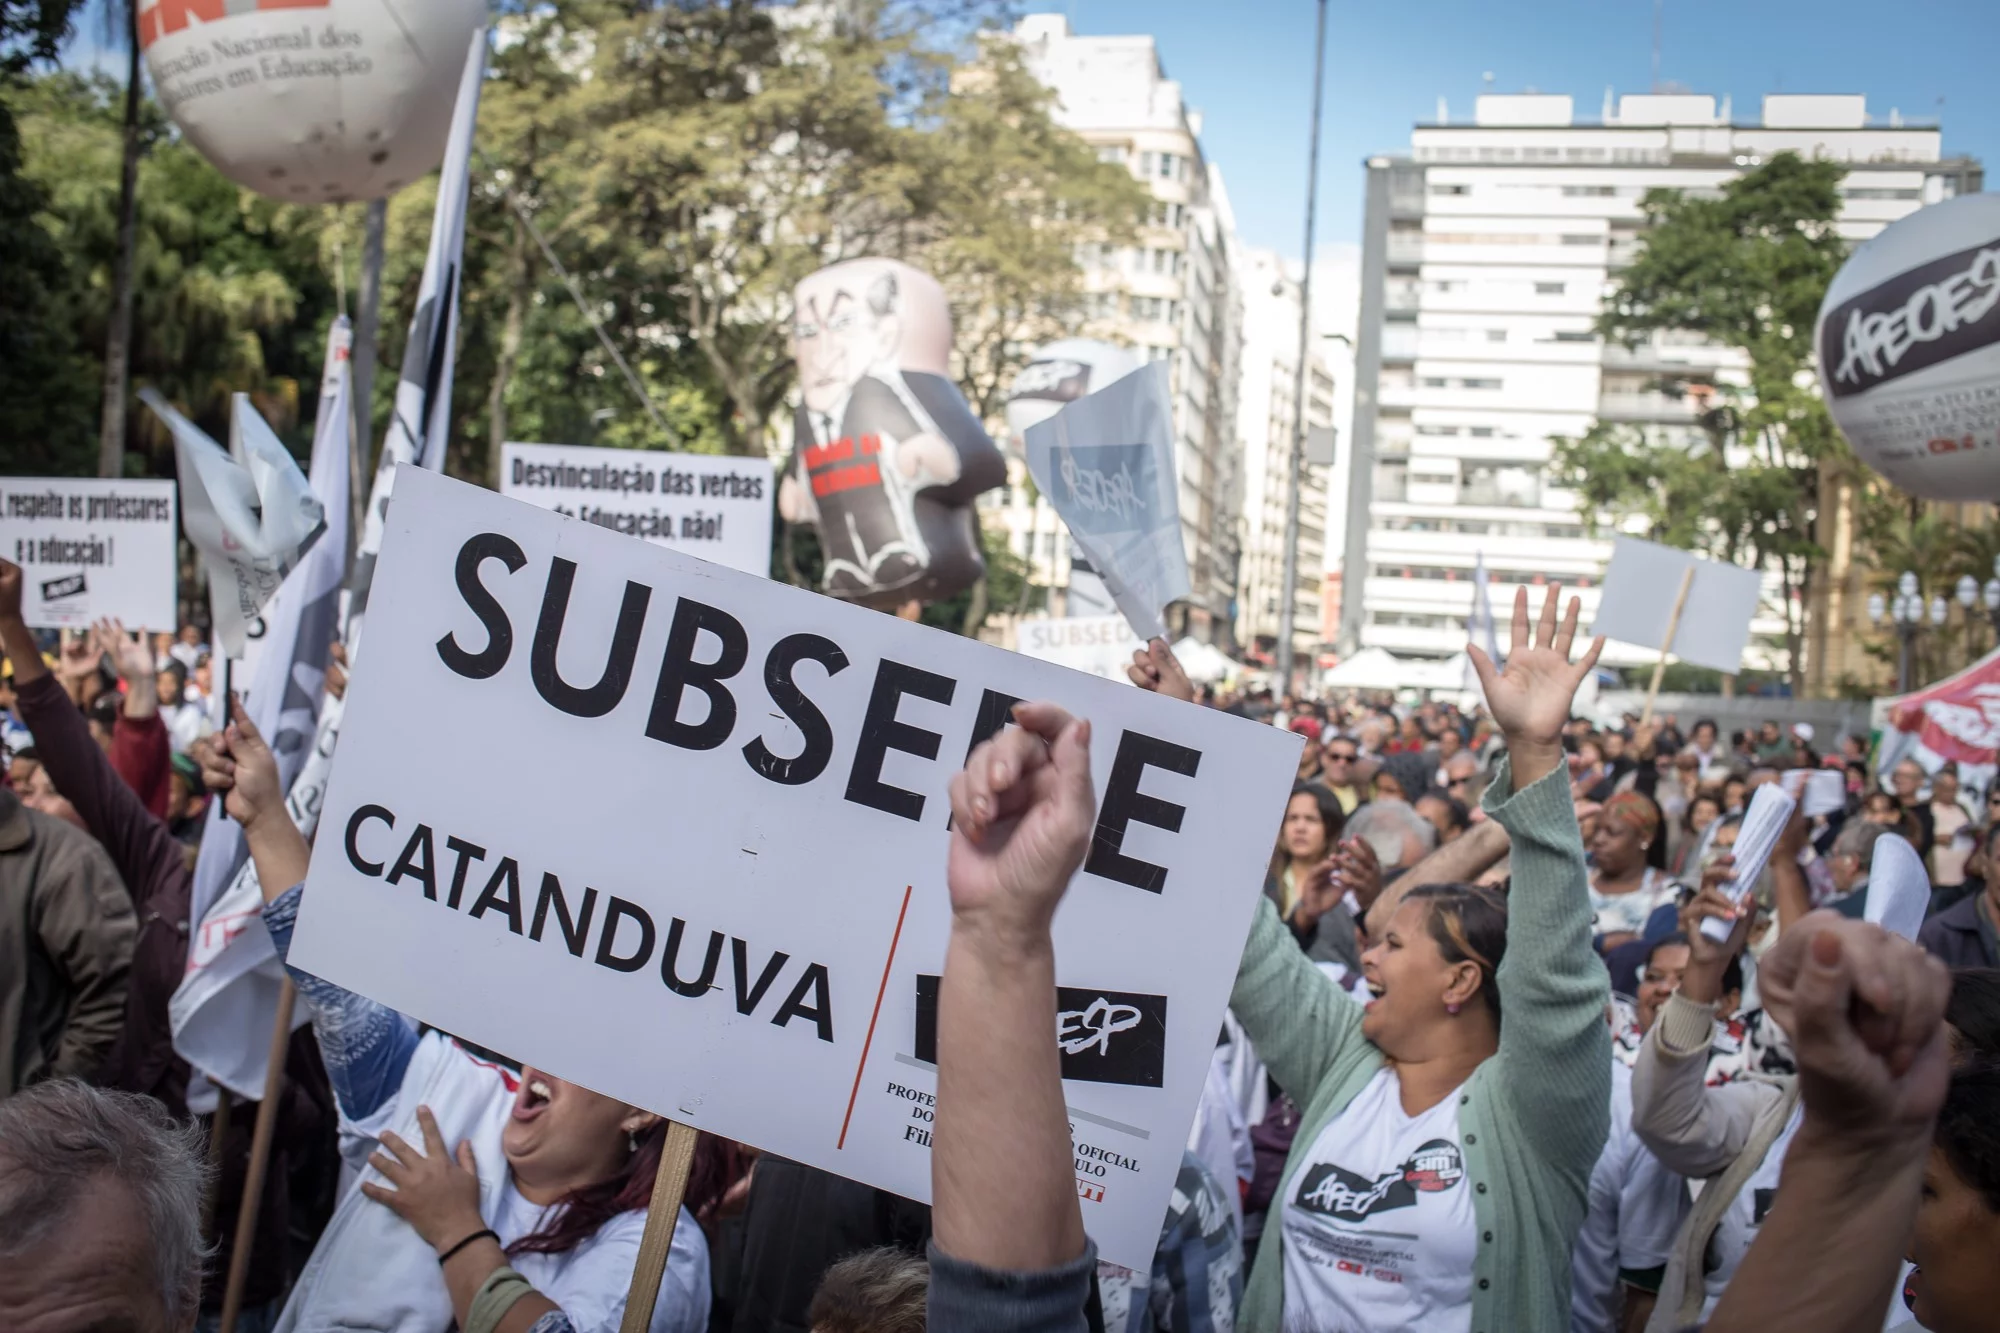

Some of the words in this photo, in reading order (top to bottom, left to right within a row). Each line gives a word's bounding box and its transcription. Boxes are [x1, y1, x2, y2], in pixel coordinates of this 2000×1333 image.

[210, 26, 311, 59] Nacional
[319, 23, 362, 49] dos
[260, 53, 373, 81] Educação
[1835, 248, 2000, 384] APEOES
[512, 457, 654, 498] Desvinculação
[661, 466, 694, 496] das
[700, 471, 764, 500] verbas
[681, 510, 723, 541] não!
[1031, 620, 1133, 650] SUBSED
[435, 533, 1202, 894] SUBSEE
[345, 804, 834, 1042] CATANDUVA
[1056, 997, 1142, 1056] ESP
[886, 1082, 936, 1107] PROFE
[1078, 1143, 1140, 1172] OFICIAL
[903, 1124, 934, 1148] Fili
[1074, 1158, 1106, 1177] ULO
